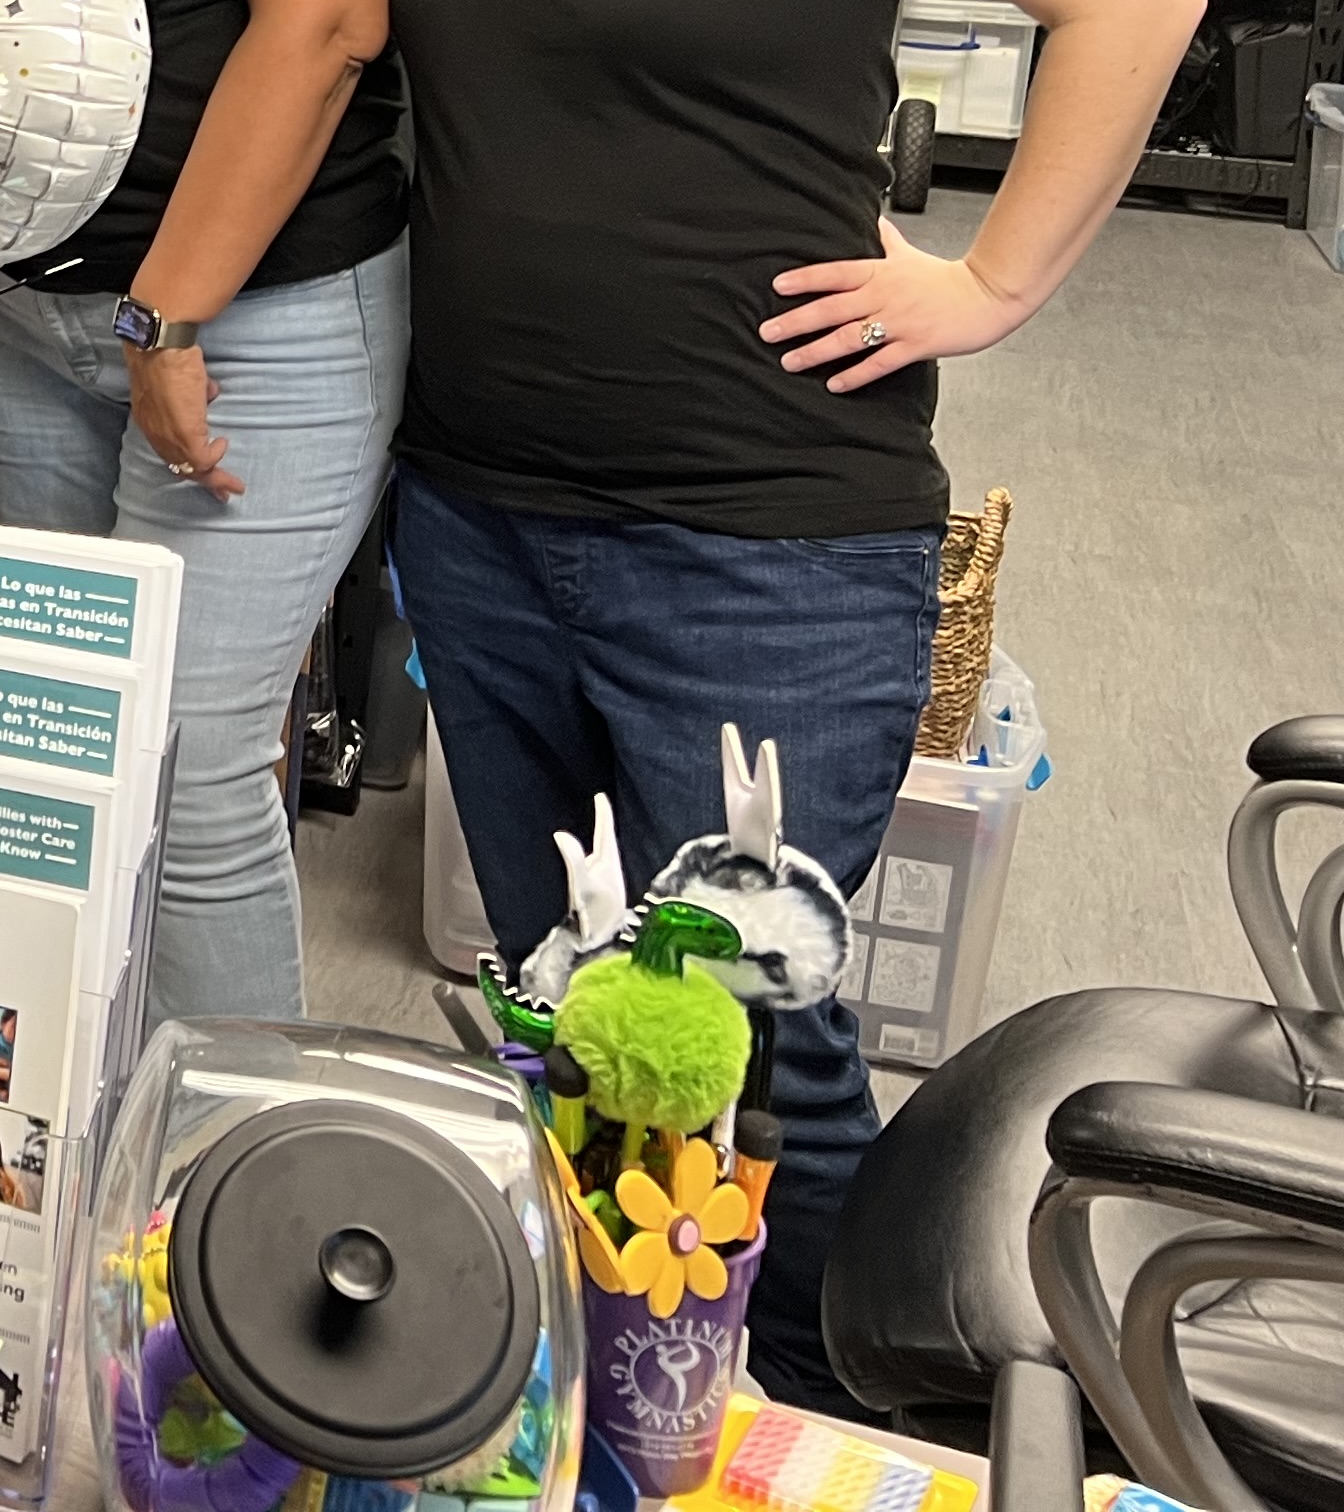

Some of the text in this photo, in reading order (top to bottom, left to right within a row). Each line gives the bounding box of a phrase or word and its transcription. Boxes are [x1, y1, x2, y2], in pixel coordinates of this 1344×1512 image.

[0, 576, 82, 602] Lo que las
[18, 600, 41, 615] en
[43, 600, 130, 629] Transición
[55, 621, 104, 643] Saber
[7, 690, 39, 710] que
[41, 695, 65, 714] las
[1, 709, 24, 726] en
[25, 711, 113, 744] Transición
[37, 734, 87, 759] Saber
[29, 811, 64, 830] with
[0, 839, 42, 860] Know
[40, 831, 77, 850] Care
